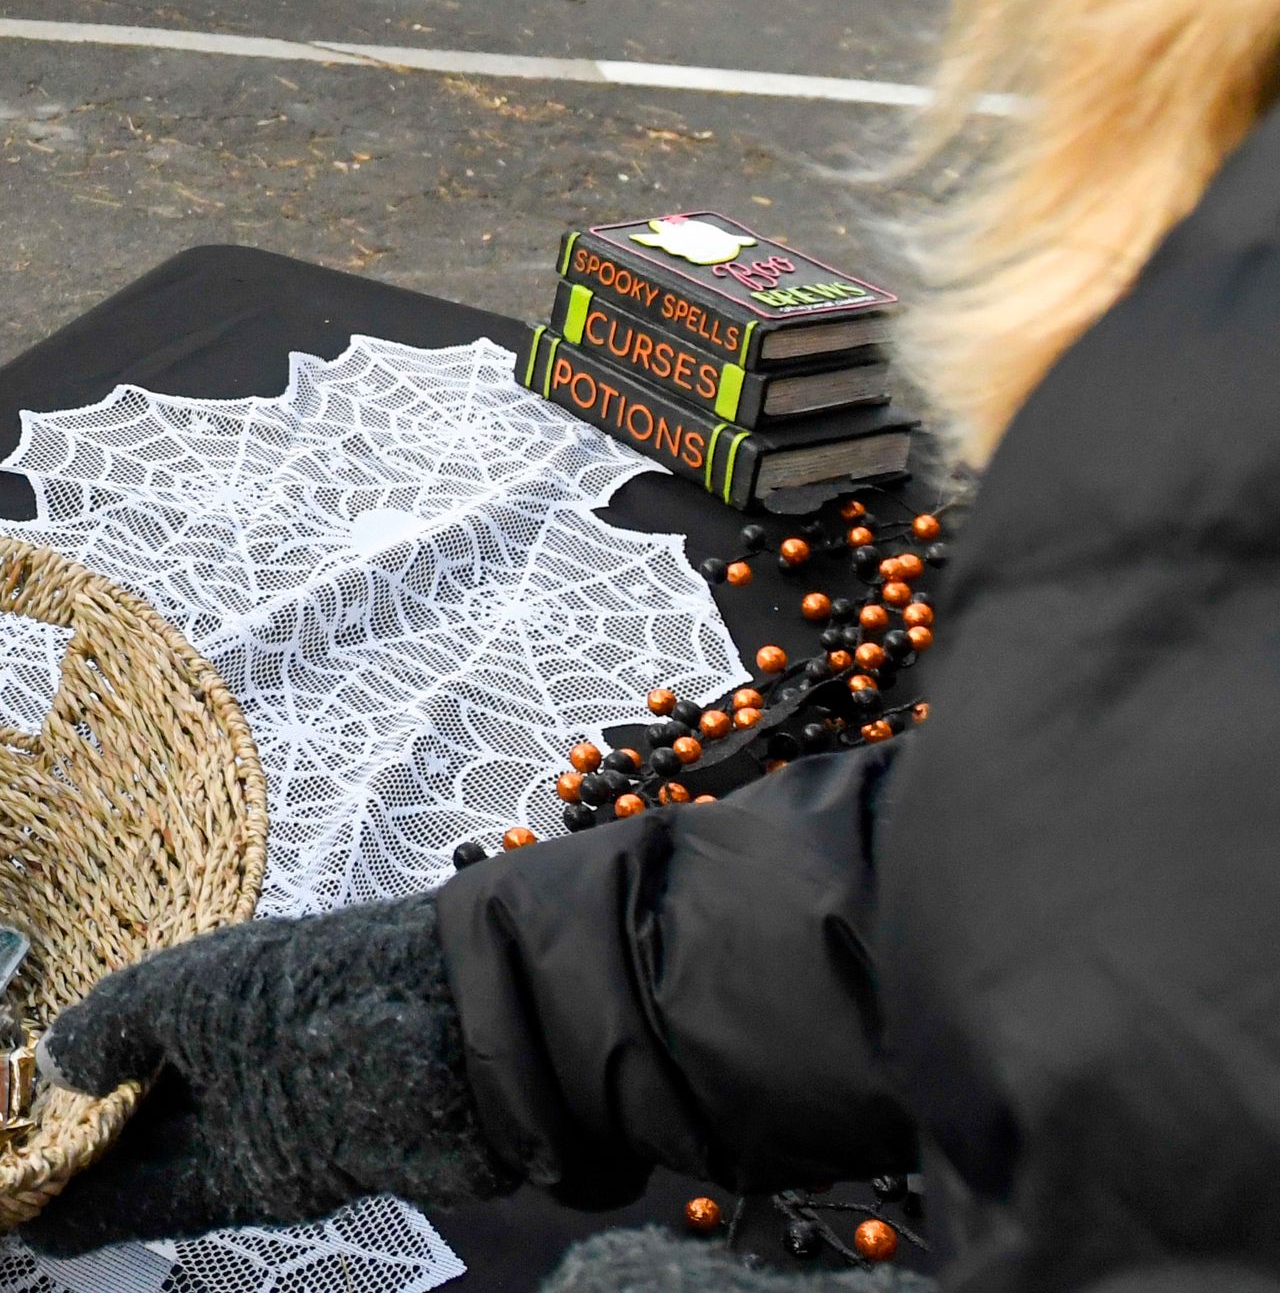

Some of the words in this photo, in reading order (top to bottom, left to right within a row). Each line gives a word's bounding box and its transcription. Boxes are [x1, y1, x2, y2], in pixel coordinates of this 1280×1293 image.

[573, 249, 659, 308] SPOOKY
[663, 294, 741, 353] SPELLS
[712, 255, 797, 292] Boo
[750, 281, 867, 308] BREWS
[584, 311, 720, 400] CURSES
[552, 357, 706, 469] POTIONS
